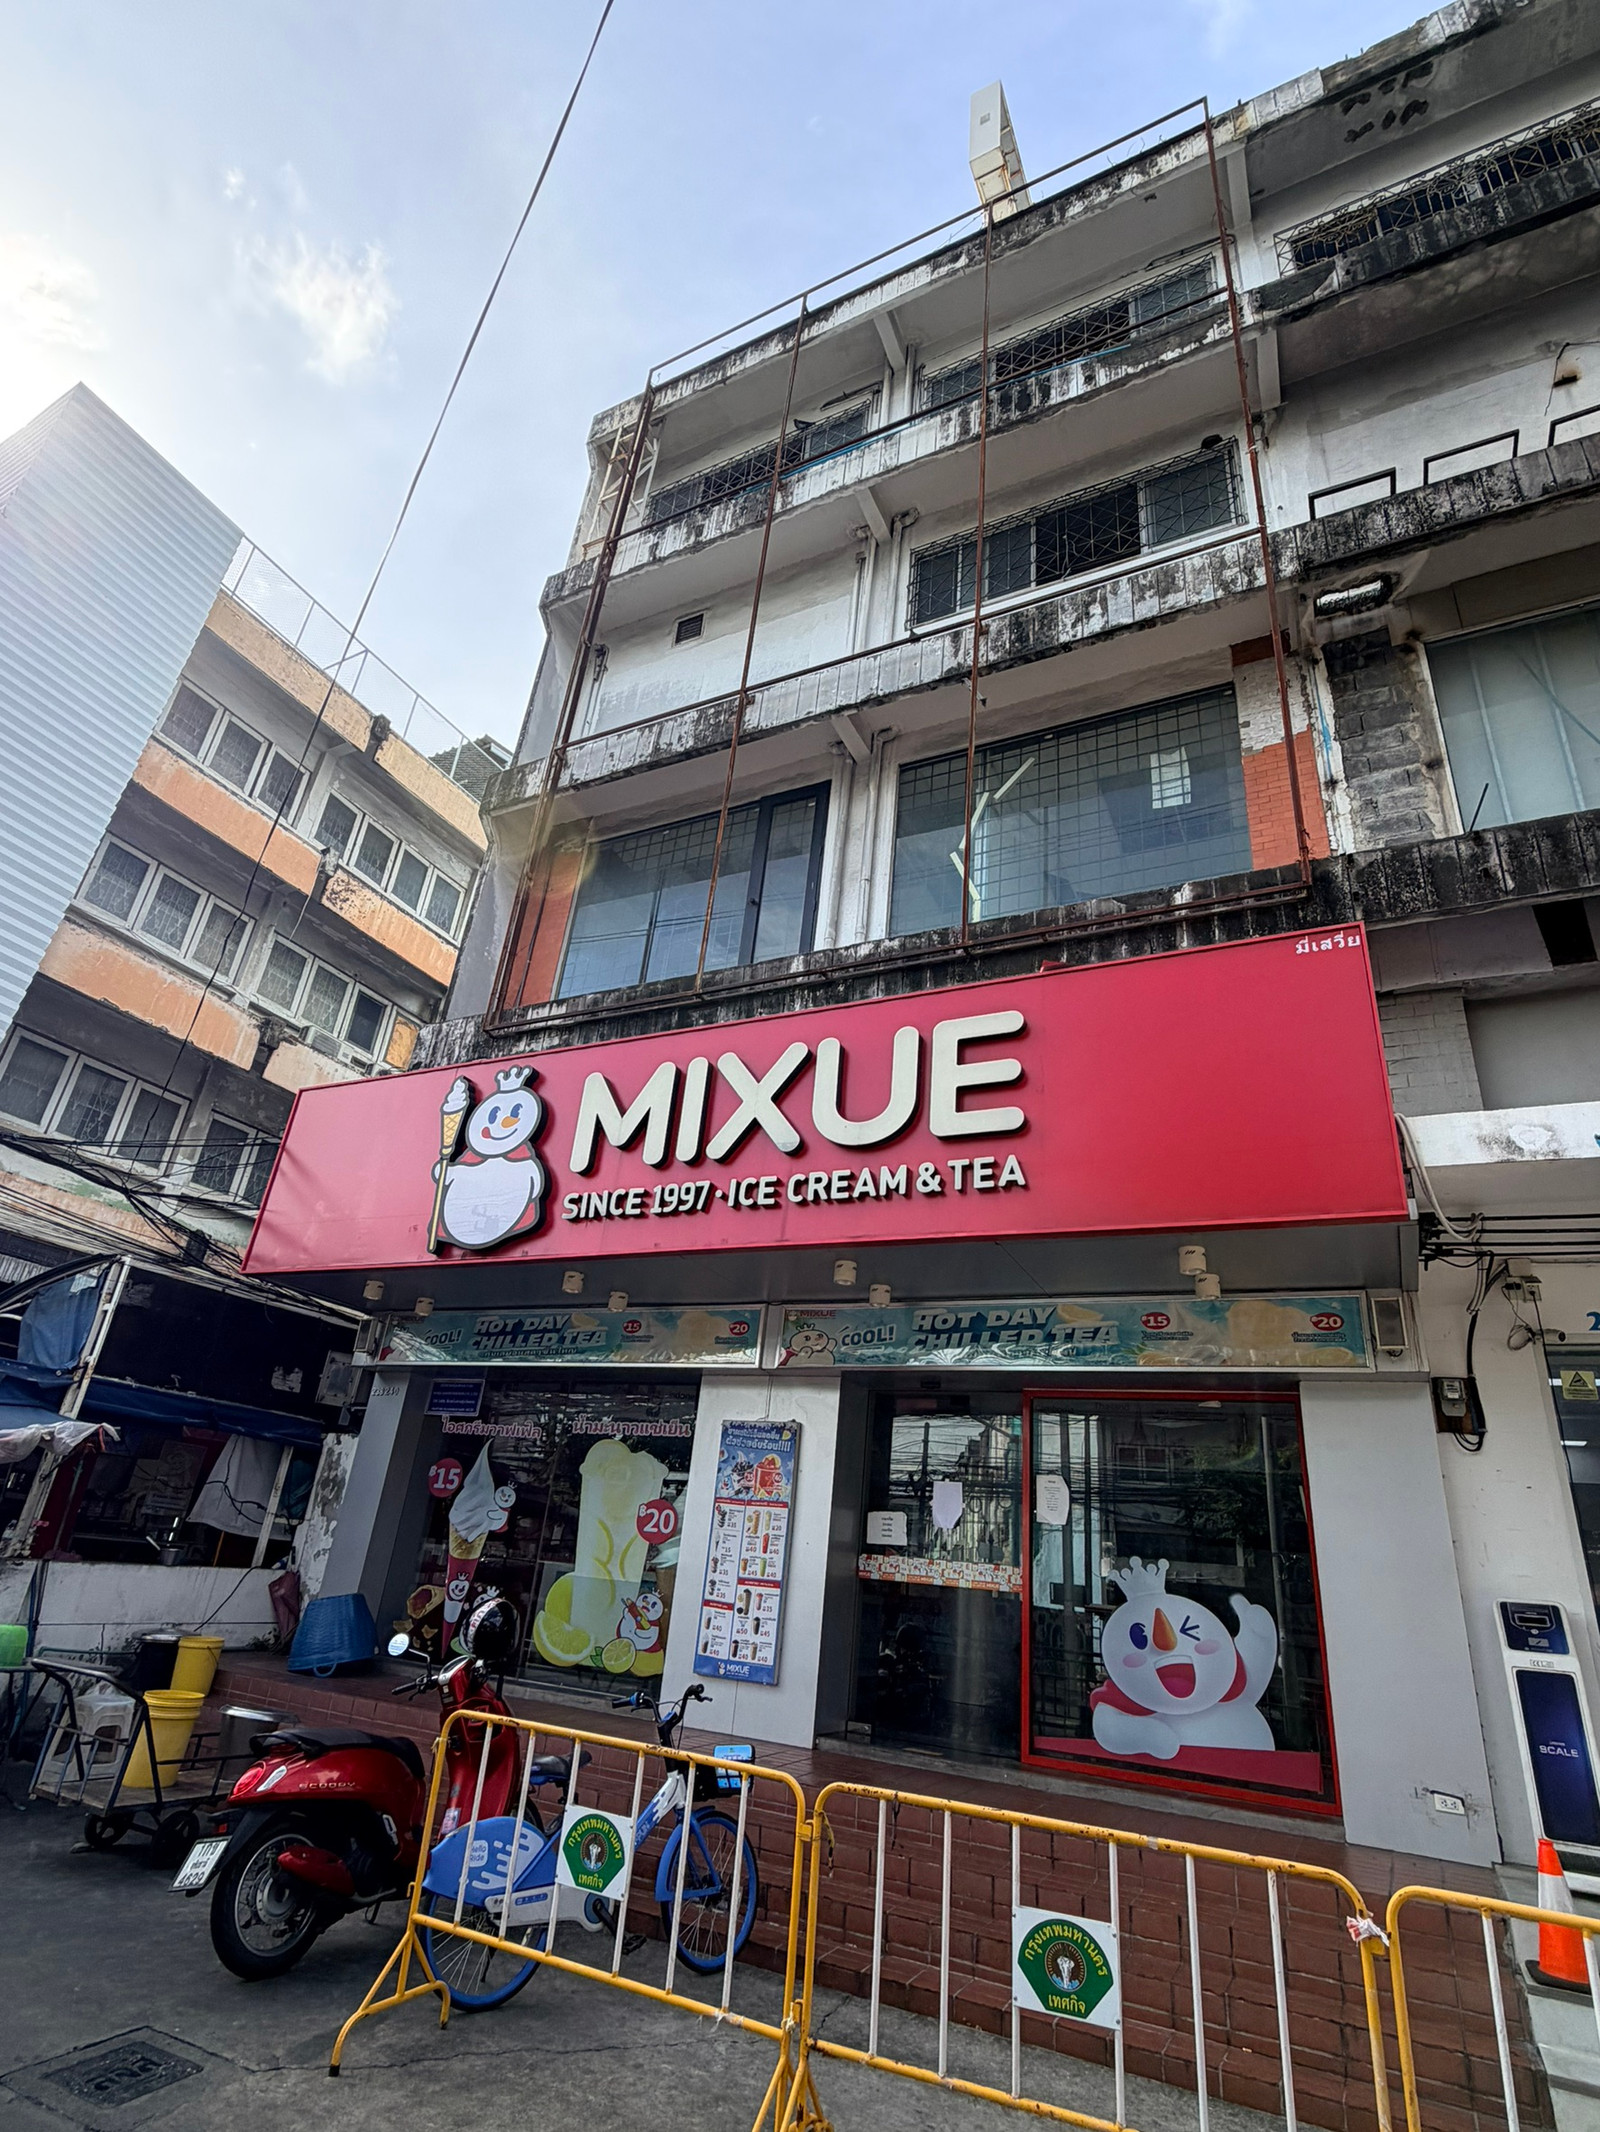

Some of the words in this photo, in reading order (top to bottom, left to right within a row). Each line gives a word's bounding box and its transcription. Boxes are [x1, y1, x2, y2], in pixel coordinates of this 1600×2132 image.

[568, 1010, 1026, 1174] MIXUE
[561, 1187, 646, 1221] SINCE
[650, 1180, 711, 1214] 1997
[727, 1175, 779, 1207] ICE
[787, 1165, 908, 1204] CREAM
[915, 1162, 943, 1194] &
[947, 1154, 1027, 1191] TEA
[473, 1315, 519, 1334] HOT
[522, 1313, 571, 1331] DAY
[800, 1309, 837, 1317] MIXUE
[912, 1309, 978, 1331] HOT
[986, 1305, 1057, 1328] DAY
[424, 1329, 464, 1346] COOL!
[470, 1332, 561, 1350] CHILLED
[562, 1326, 608, 1347] TEA
[841, 1325, 895, 1346] COOL!
[908, 1329, 1045, 1350] CHILLED
[1052, 1321, 1121, 1346] TEA
[726, 1663, 751, 1675] MIXUE
[1539, 1744, 1579, 1758] SCALE
[568, 1818, 623, 1860] กรุงเทพมหานคร
[578, 1873, 604, 1889] เทศกิจ
[1024, 1923, 1109, 1977] กรุงเทพมหานคร
[1048, 1993, 1086, 2014] เทศกิจ
